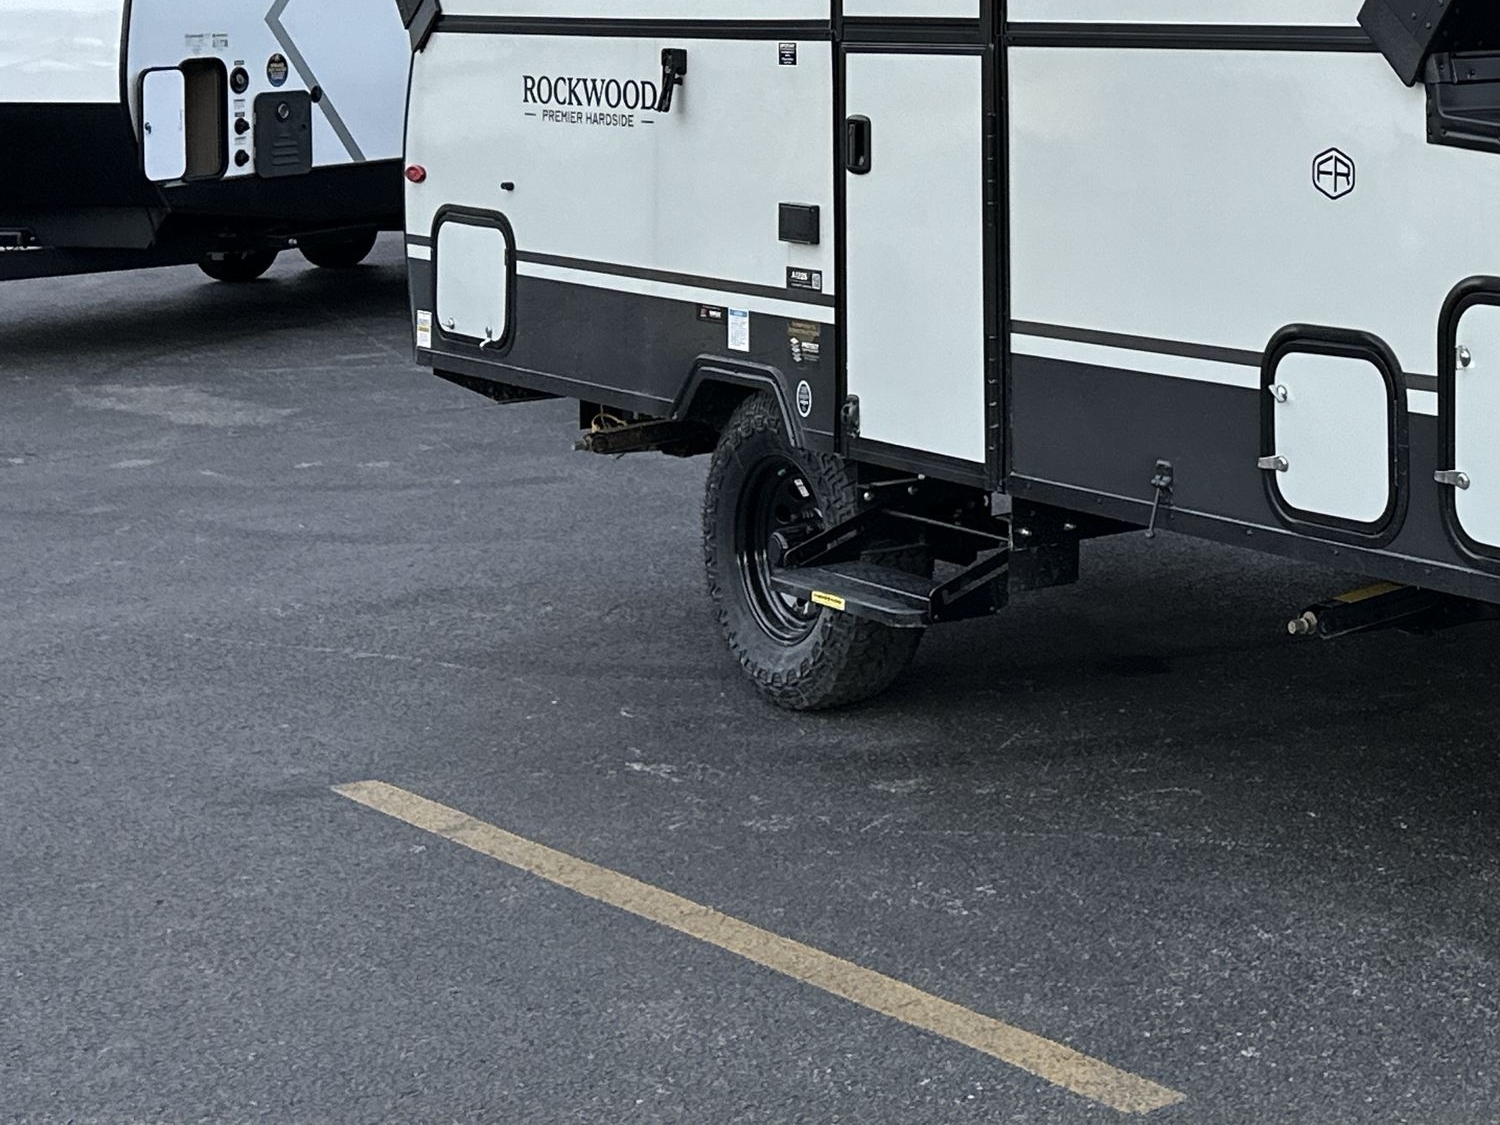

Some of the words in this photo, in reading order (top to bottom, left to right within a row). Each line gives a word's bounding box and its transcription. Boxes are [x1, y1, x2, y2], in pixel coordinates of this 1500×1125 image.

[522, 75, 658, 111] ROCKWOOD
[542, 109, 583, 124] PREMIER
[586, 112, 635, 127] HARDSIDE
